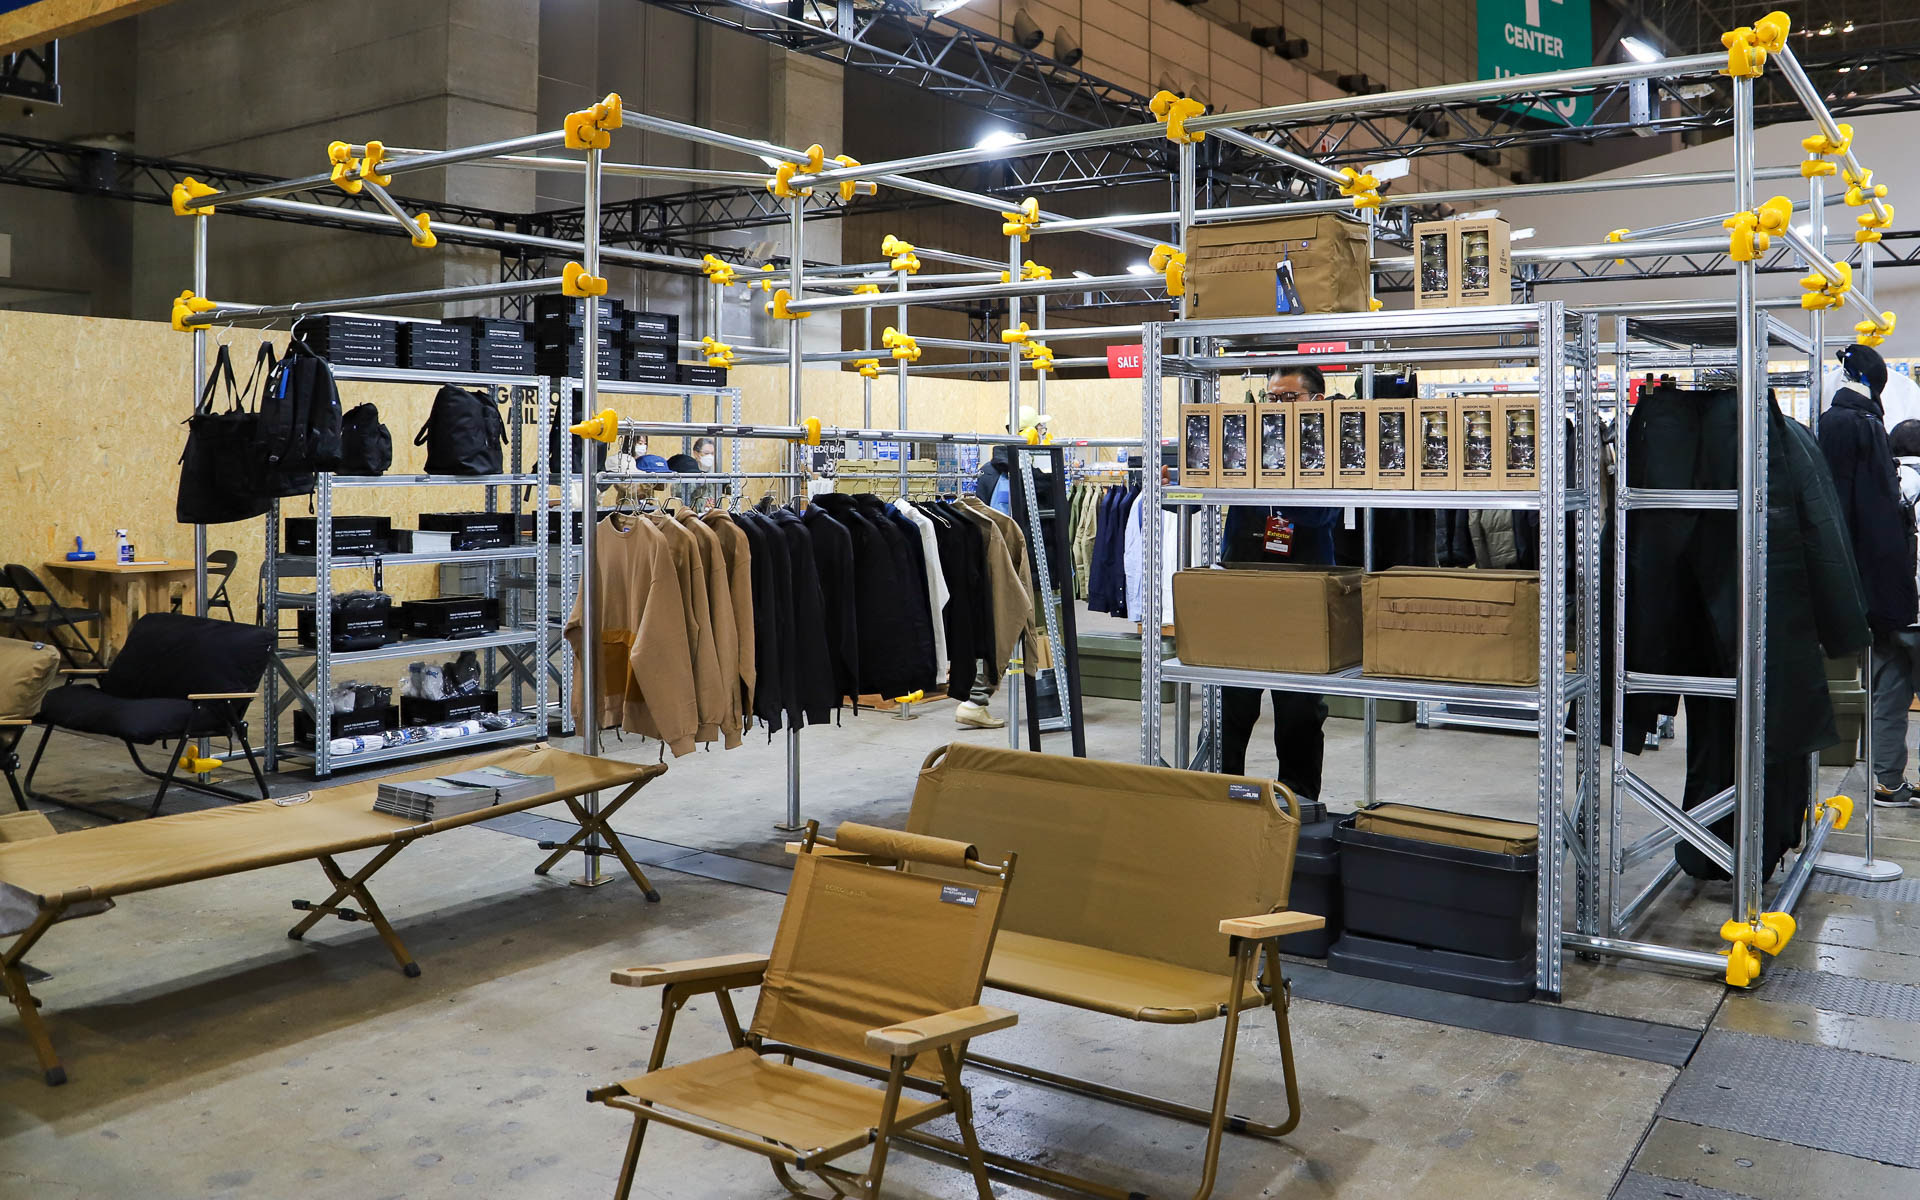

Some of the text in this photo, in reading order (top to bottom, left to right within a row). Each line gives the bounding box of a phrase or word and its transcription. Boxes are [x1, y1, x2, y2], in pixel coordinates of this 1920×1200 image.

[1504, 23, 1564, 58] CENTER
[1117, 356, 1139, 369] SALE
[814, 445, 845, 454] ECO BAG
